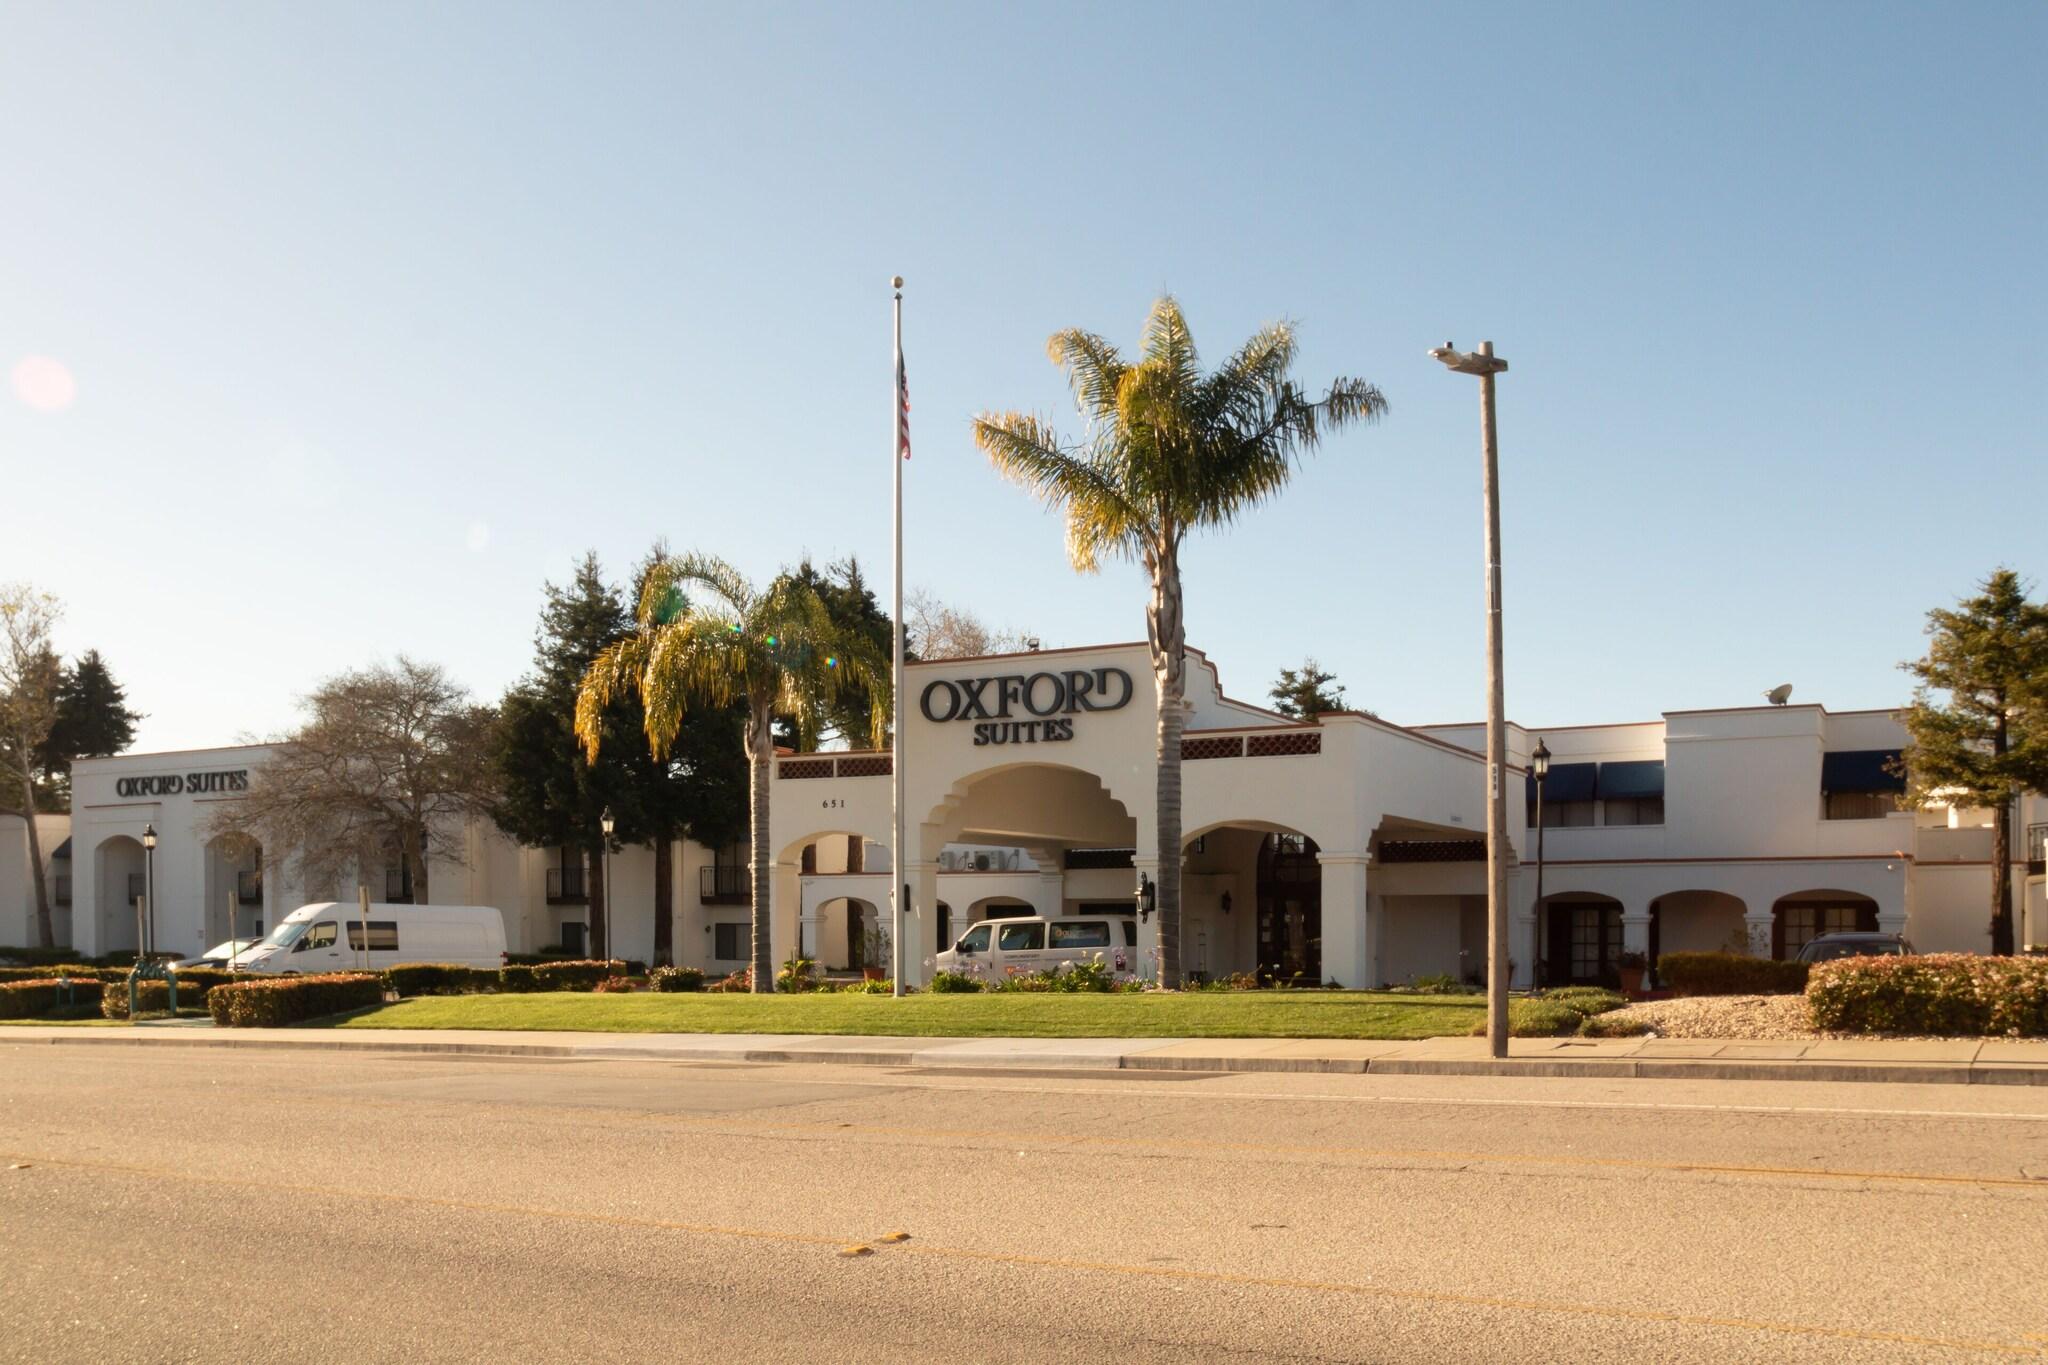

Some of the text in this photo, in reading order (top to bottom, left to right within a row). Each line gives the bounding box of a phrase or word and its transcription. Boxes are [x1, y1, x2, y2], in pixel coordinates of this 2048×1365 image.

[920, 668, 1133, 722] OXFORD
[974, 719, 1074, 745] SUITES
[117, 770, 248, 797] OXFORD SUITES
[822, 799, 844, 808] 651
